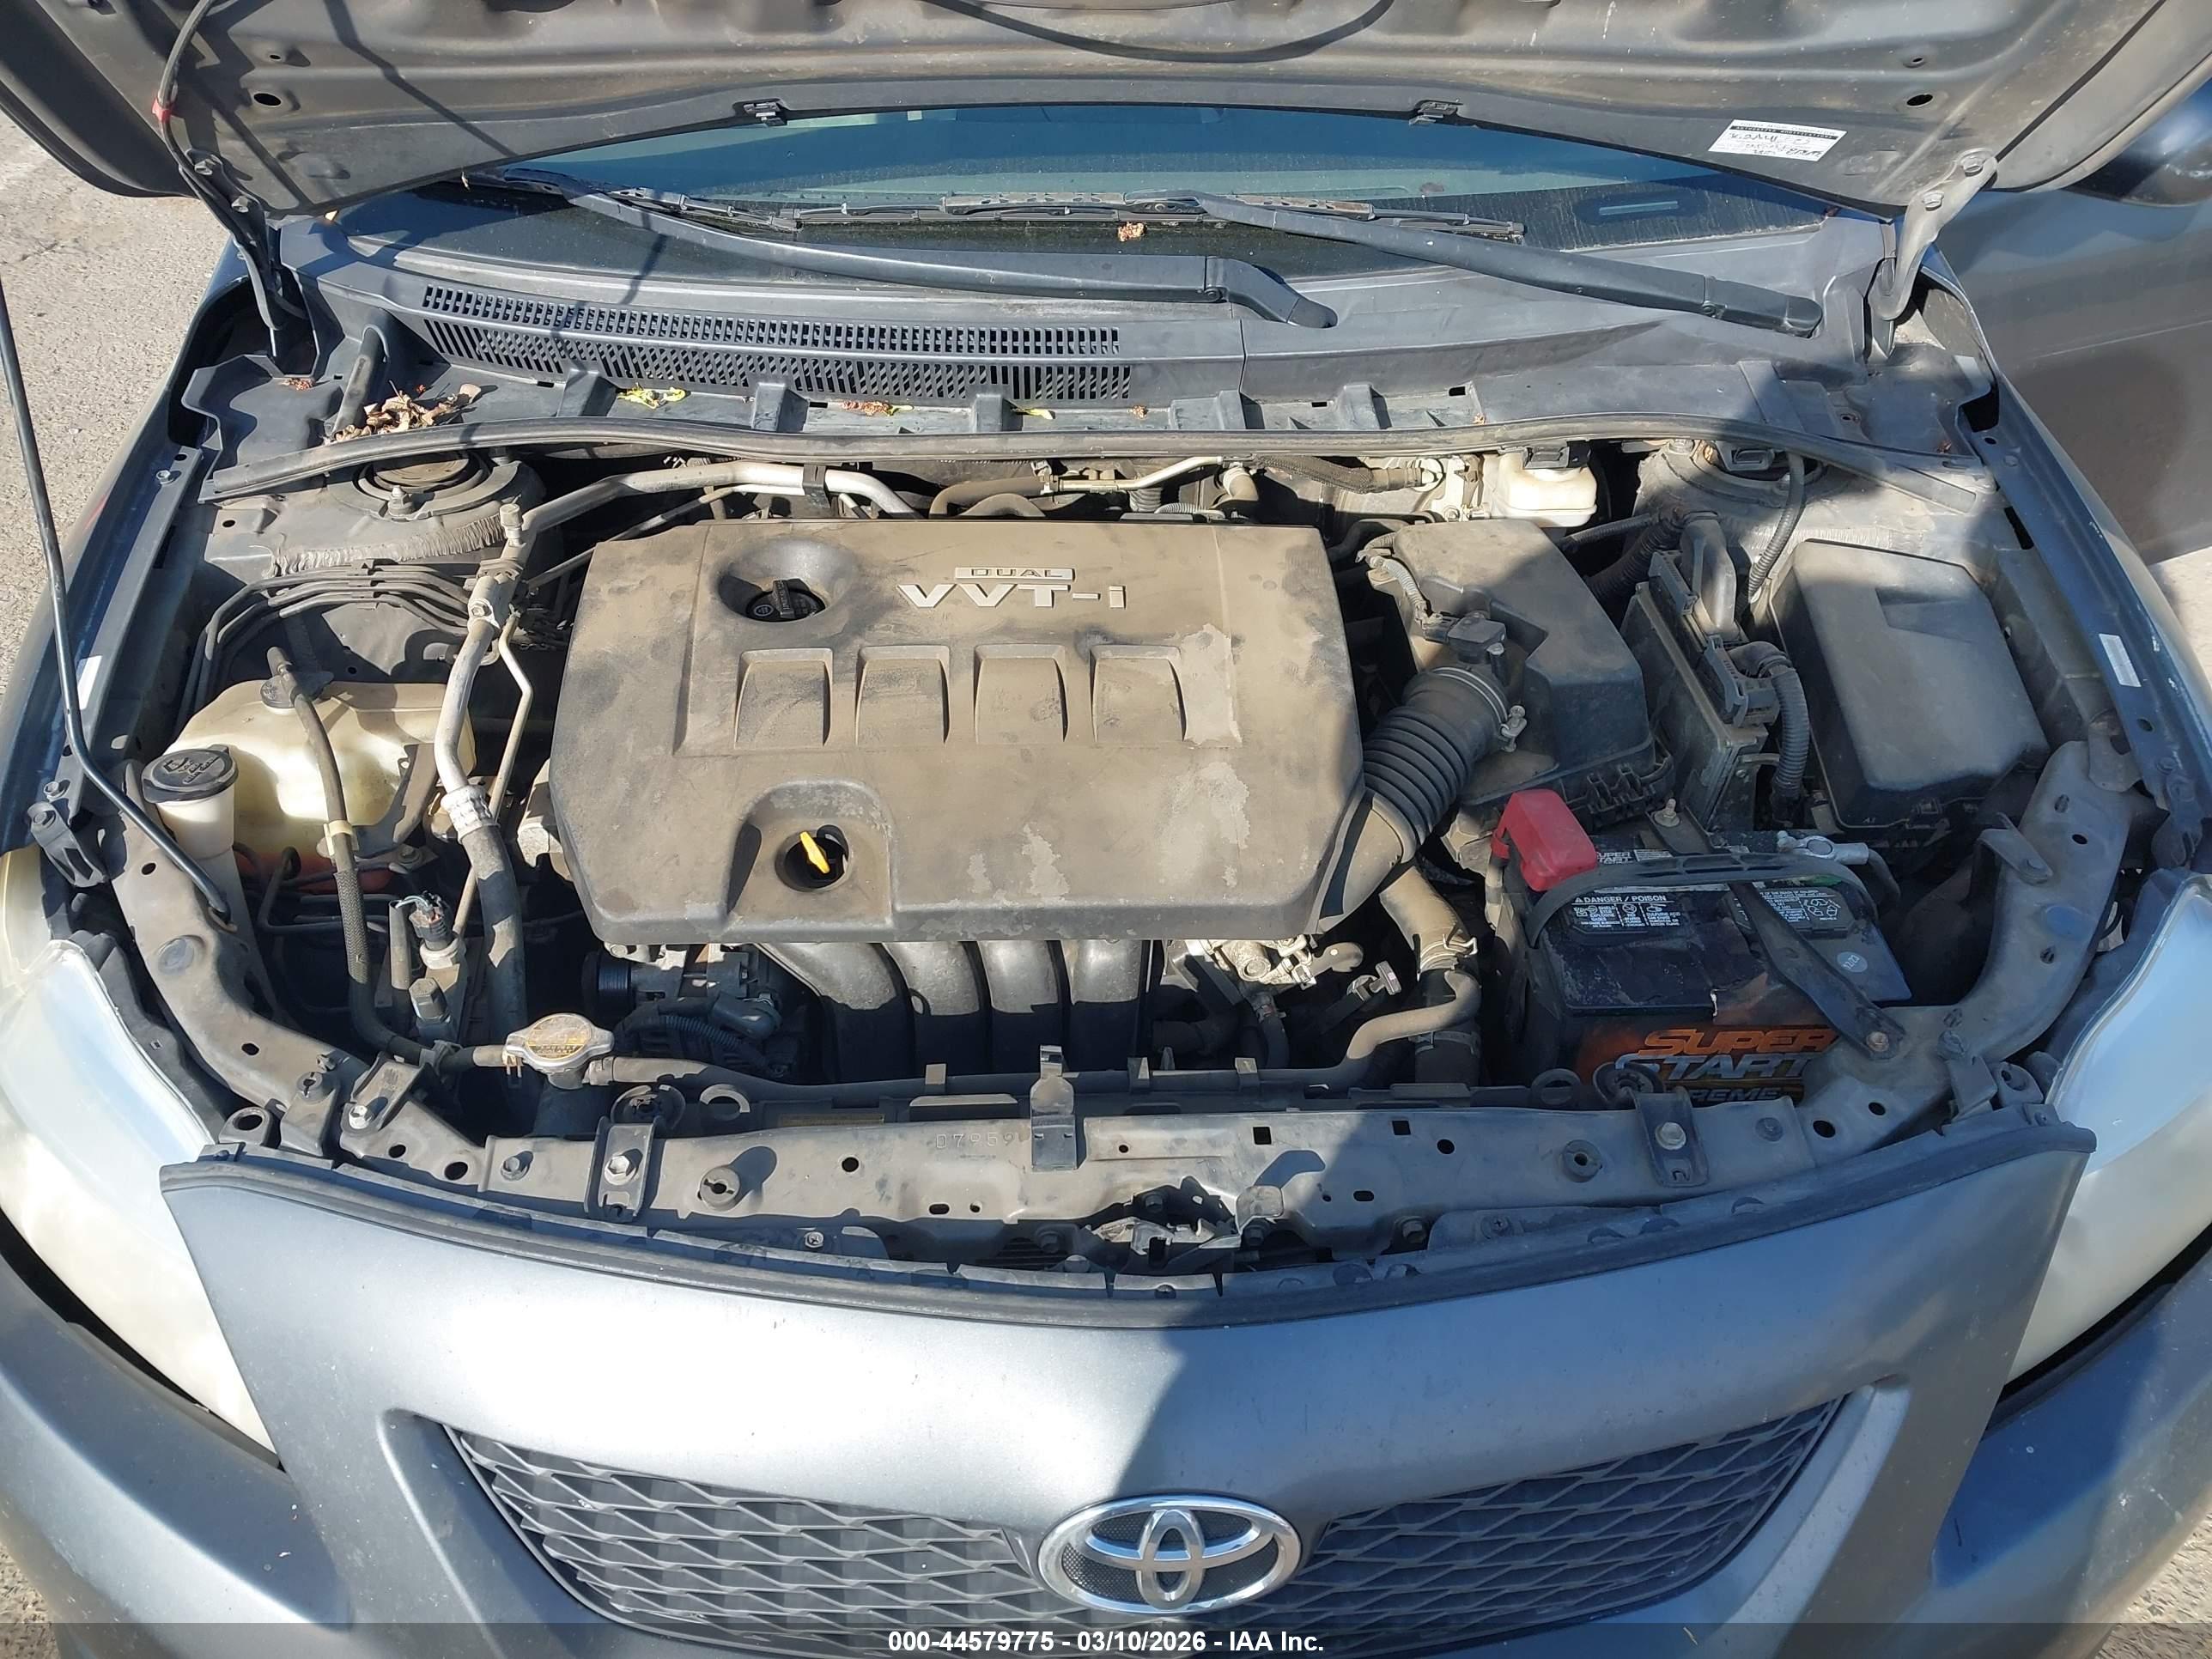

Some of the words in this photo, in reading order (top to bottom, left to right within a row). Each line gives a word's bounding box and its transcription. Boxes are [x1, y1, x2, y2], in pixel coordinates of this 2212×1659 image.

[971, 568, 1062, 578] DUAL
[1638, 1029, 1839, 1056] SUPER
[1614, 1053, 1822, 1080] START
[1688, 1087, 1782, 1103] REME
